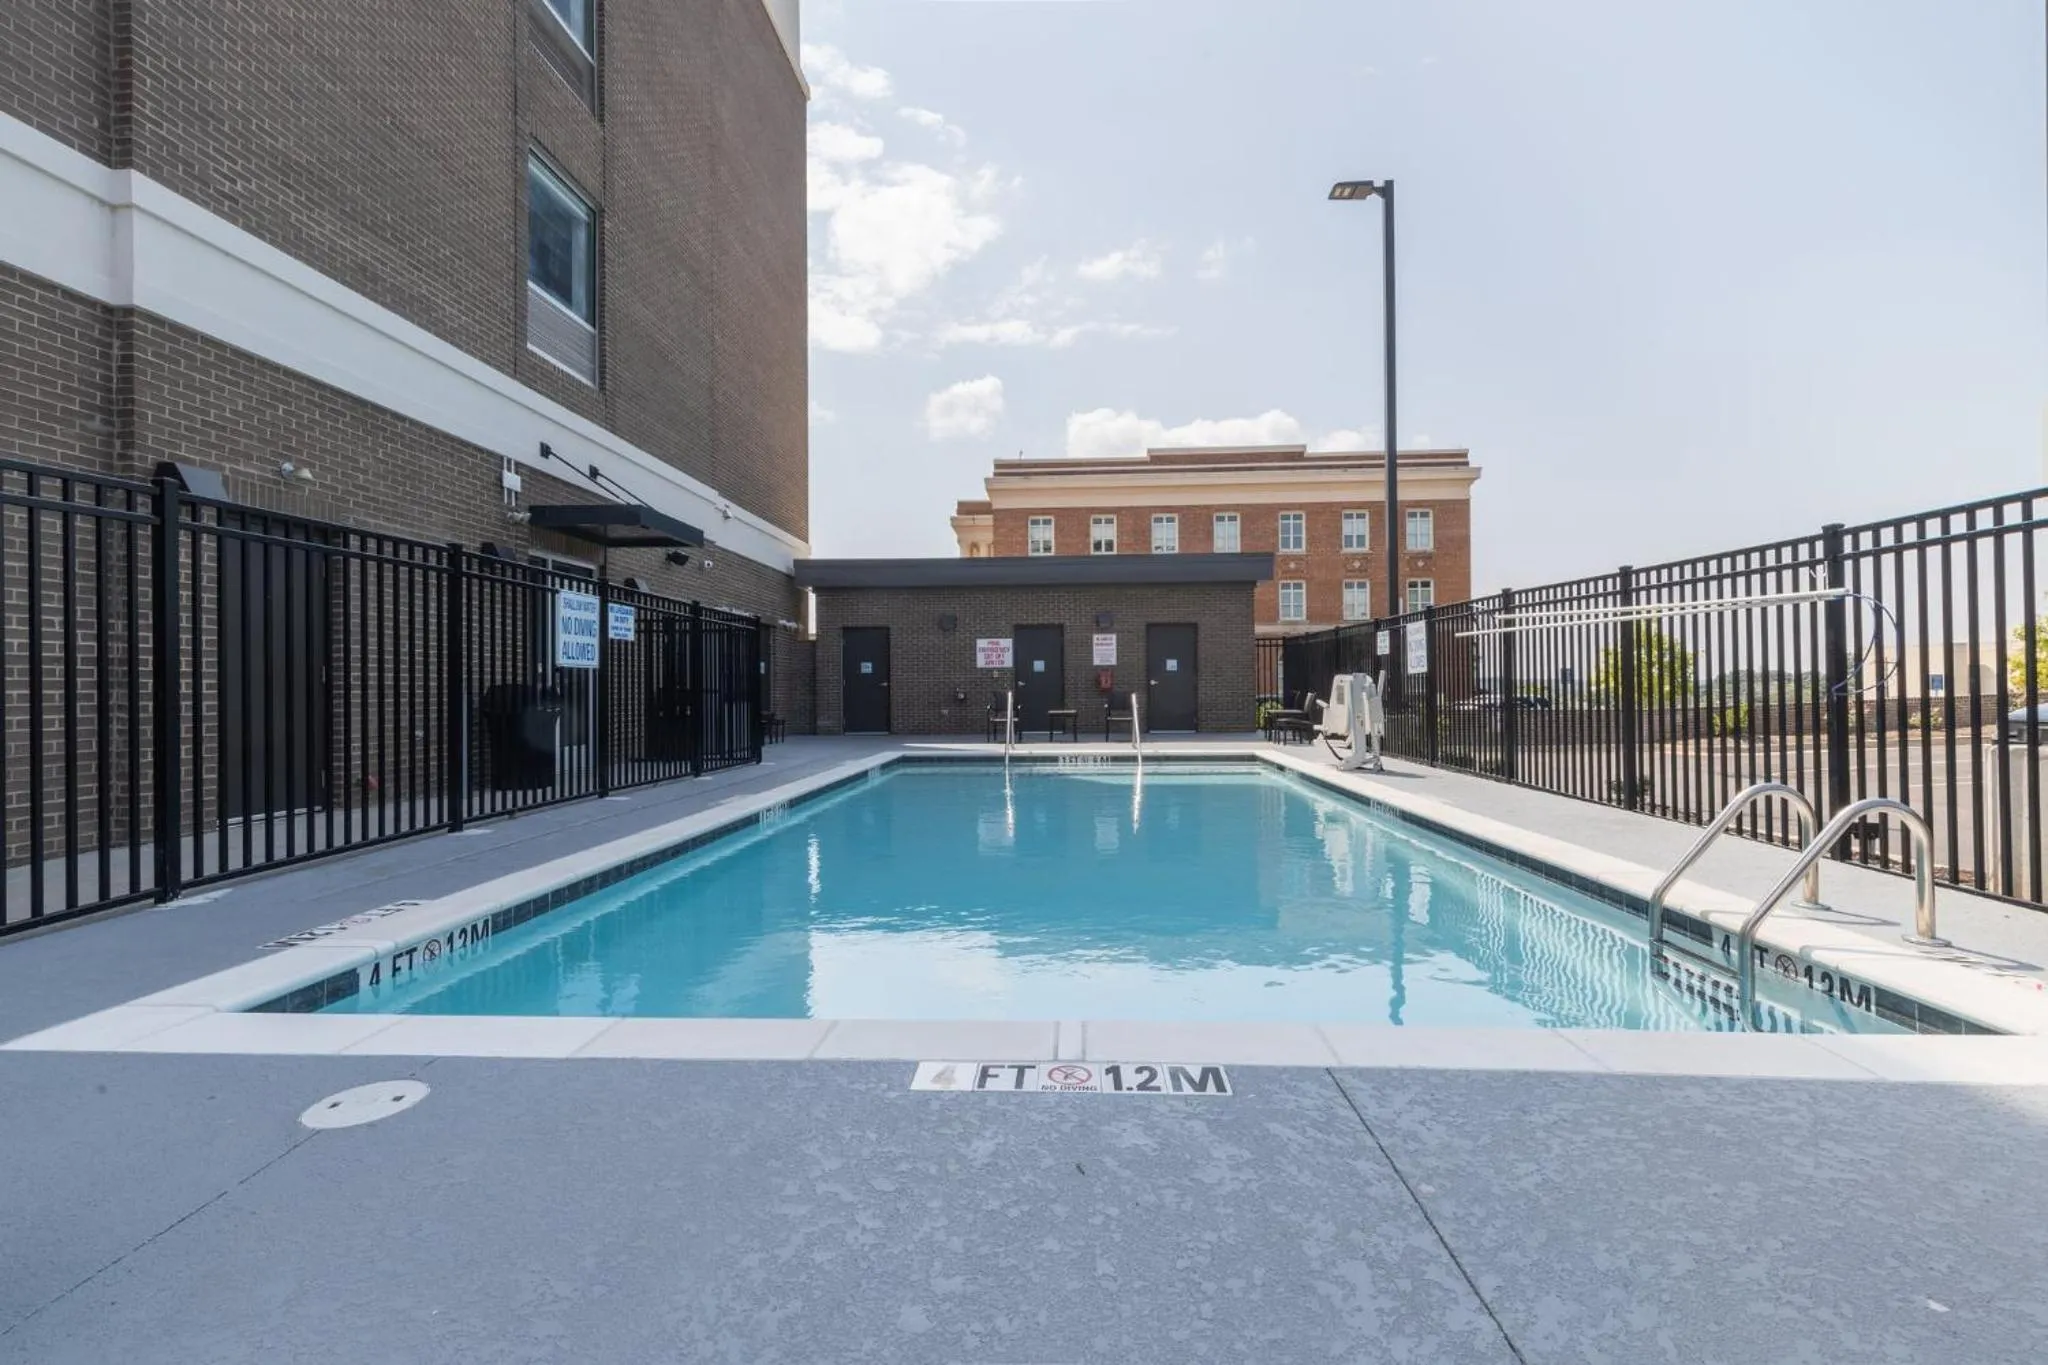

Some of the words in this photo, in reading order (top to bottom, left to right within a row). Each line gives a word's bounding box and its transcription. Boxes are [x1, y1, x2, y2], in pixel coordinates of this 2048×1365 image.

[562, 615, 573, 635] NO
[574, 617, 597, 638] DIVING
[562, 641, 596, 661] ALLOWED
[368, 961, 380, 985] 4
[392, 946, 418, 978] FT
[1754, 944, 1769, 968] T
[931, 1065, 956, 1086] 4
[976, 1065, 1036, 1089] FT
[1104, 1064, 1228, 1093] 1.2M
